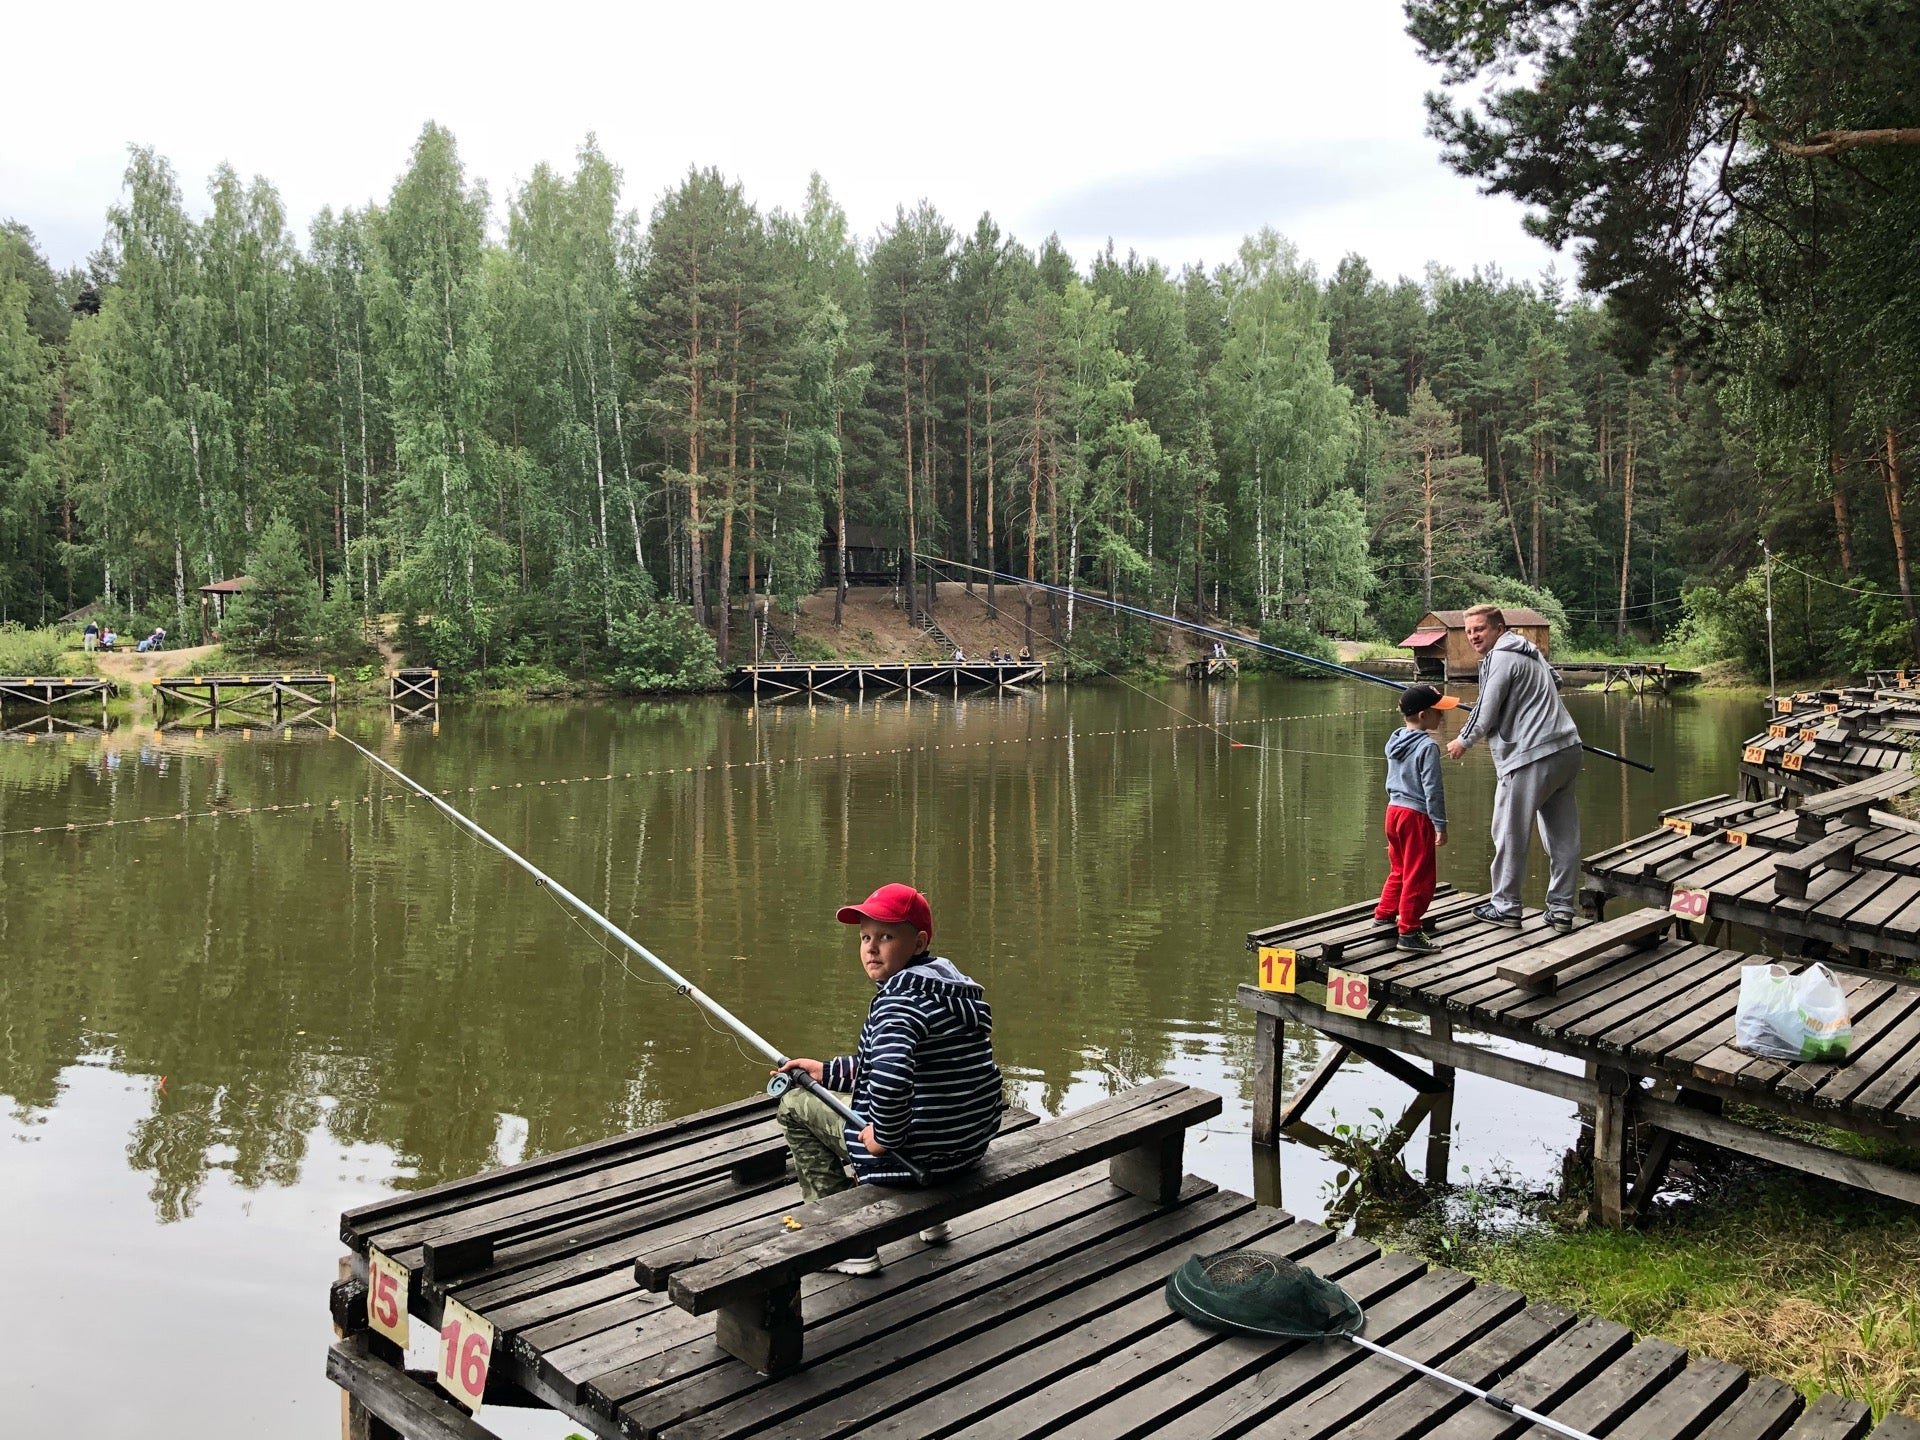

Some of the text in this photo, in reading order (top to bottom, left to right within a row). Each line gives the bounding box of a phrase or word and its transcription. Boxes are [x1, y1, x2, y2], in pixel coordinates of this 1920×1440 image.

[1779, 702, 1790, 711] 29
[1771, 727, 1784, 738] 25
[1801, 731, 1814, 741] 26
[1748, 748, 1762, 761] 23
[1784, 754, 1800, 768] 24
[1670, 889, 1707, 917] 20
[1262, 955, 1292, 985] 17
[1328, 977, 1368, 1010] 18
[369, 1262, 399, 1329] 15
[440, 1319, 490, 1397] 16
